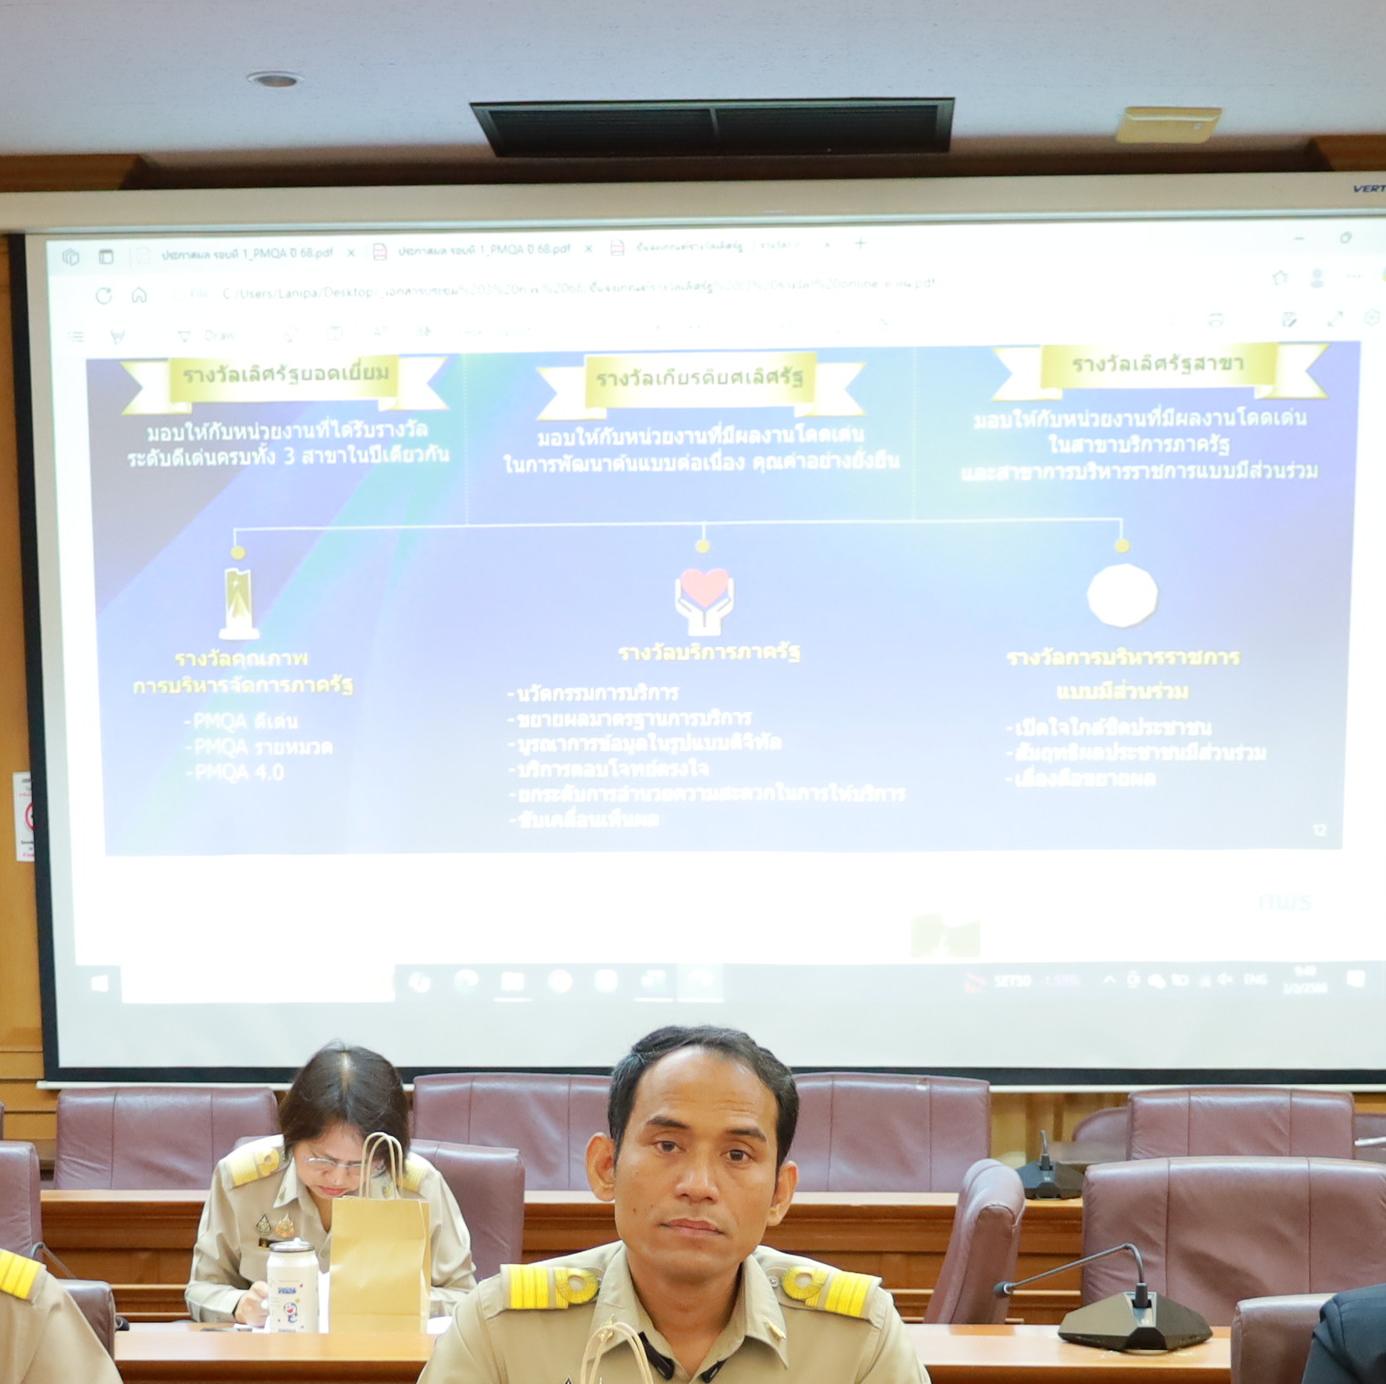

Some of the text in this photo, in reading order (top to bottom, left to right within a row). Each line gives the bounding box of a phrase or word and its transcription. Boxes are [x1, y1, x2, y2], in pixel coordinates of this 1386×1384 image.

[300, 246, 334, 260] 68.pdf
[537, 243, 571, 257] 68.pdf
[182, 359, 390, 385] รางวัลเลิศรัฐยอดเยี่ยม
[1071, 353, 1245, 375] รางวัลเลิศรัฐสาขา
[596, 366, 804, 389] รางวัลเกียรติยศเลิศรัฐ
[973, 403, 1308, 430] มอบให้กับหน่วยงานที่มีผลงานโดดเด่น
[146, 416, 428, 443] มอบให้กับหน่วยงานที่ได้รับรางวัล
[537, 420, 865, 448] มอบให้กับหน่วยงานที่มีผลงานโดดเด่น
[127, 442, 450, 468] ระดับดีเด่นครบทั้ง 3 สาขาในปีเดียวกัน
[1047, 433, 1231, 457] ในสาขาบริการภาครัฐ
[961, 459, 1319, 482] และสาขาการบริหารราชการแบบมีส่วนร่วม
[174, 648, 309, 671] รางวัลคุณภาพ
[618, 641, 802, 664] รางวัลบริการภาครัฐ
[1006, 645, 1241, 667] รางวัลการบริหารราชการ
[132, 673, 355, 697] การบริหารจัดการภาครัฐ
[1056, 679, 1190, 701] แบบมีส่วนร่วม
[254, 764, 285, 781] 4.0
[1312, 823, 1328, 838] 12
[994, 974, 1033, 988] SET50
[1243, 972, 1269, 986] ENG
